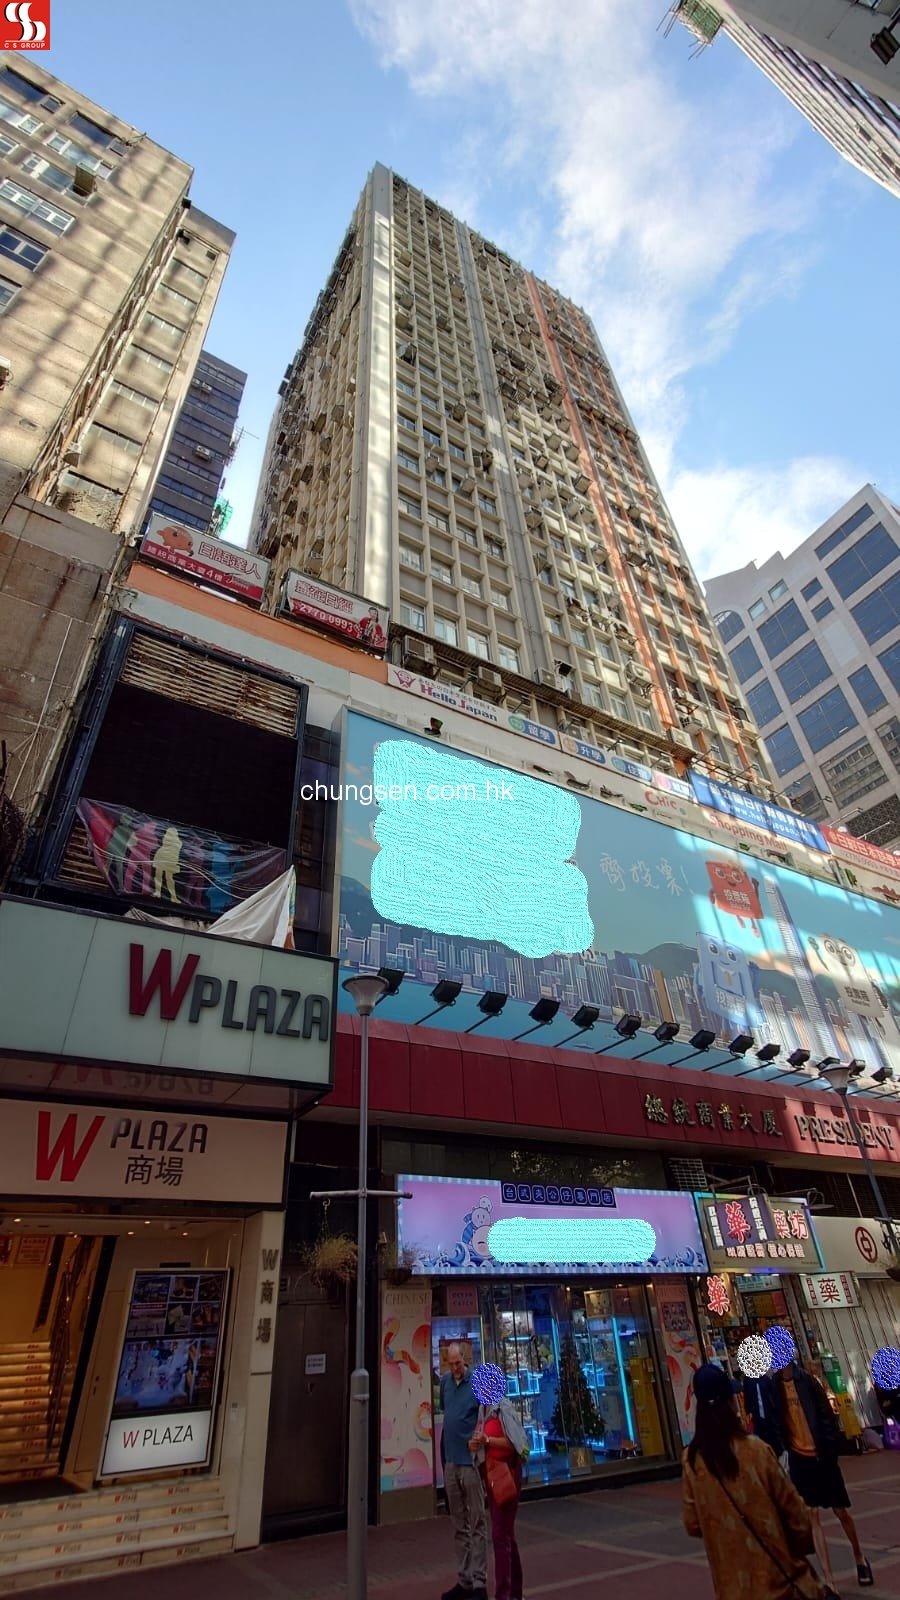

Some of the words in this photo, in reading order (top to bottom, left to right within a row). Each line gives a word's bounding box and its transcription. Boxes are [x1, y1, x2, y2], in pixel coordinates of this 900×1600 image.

[300, 603, 325, 620] 2770
[328, 617, 354, 633] 0993
[420, 683, 457, 706] Hello
[458, 699, 498, 722] Japan
[710, 814, 765, 846] Shopping
[765, 835, 788, 851] Mall
[189, 974, 330, 1041] PLAZA
[644, 1093, 783, 1137] 總統商業大廈
[35, 1110, 106, 1182] W
[110, 1117, 209, 1153] PLAZA
[124, 1154, 184, 1187] 商場
[122, 1430, 140, 1449] W
[142, 1424, 195, 1447] PLAZA
